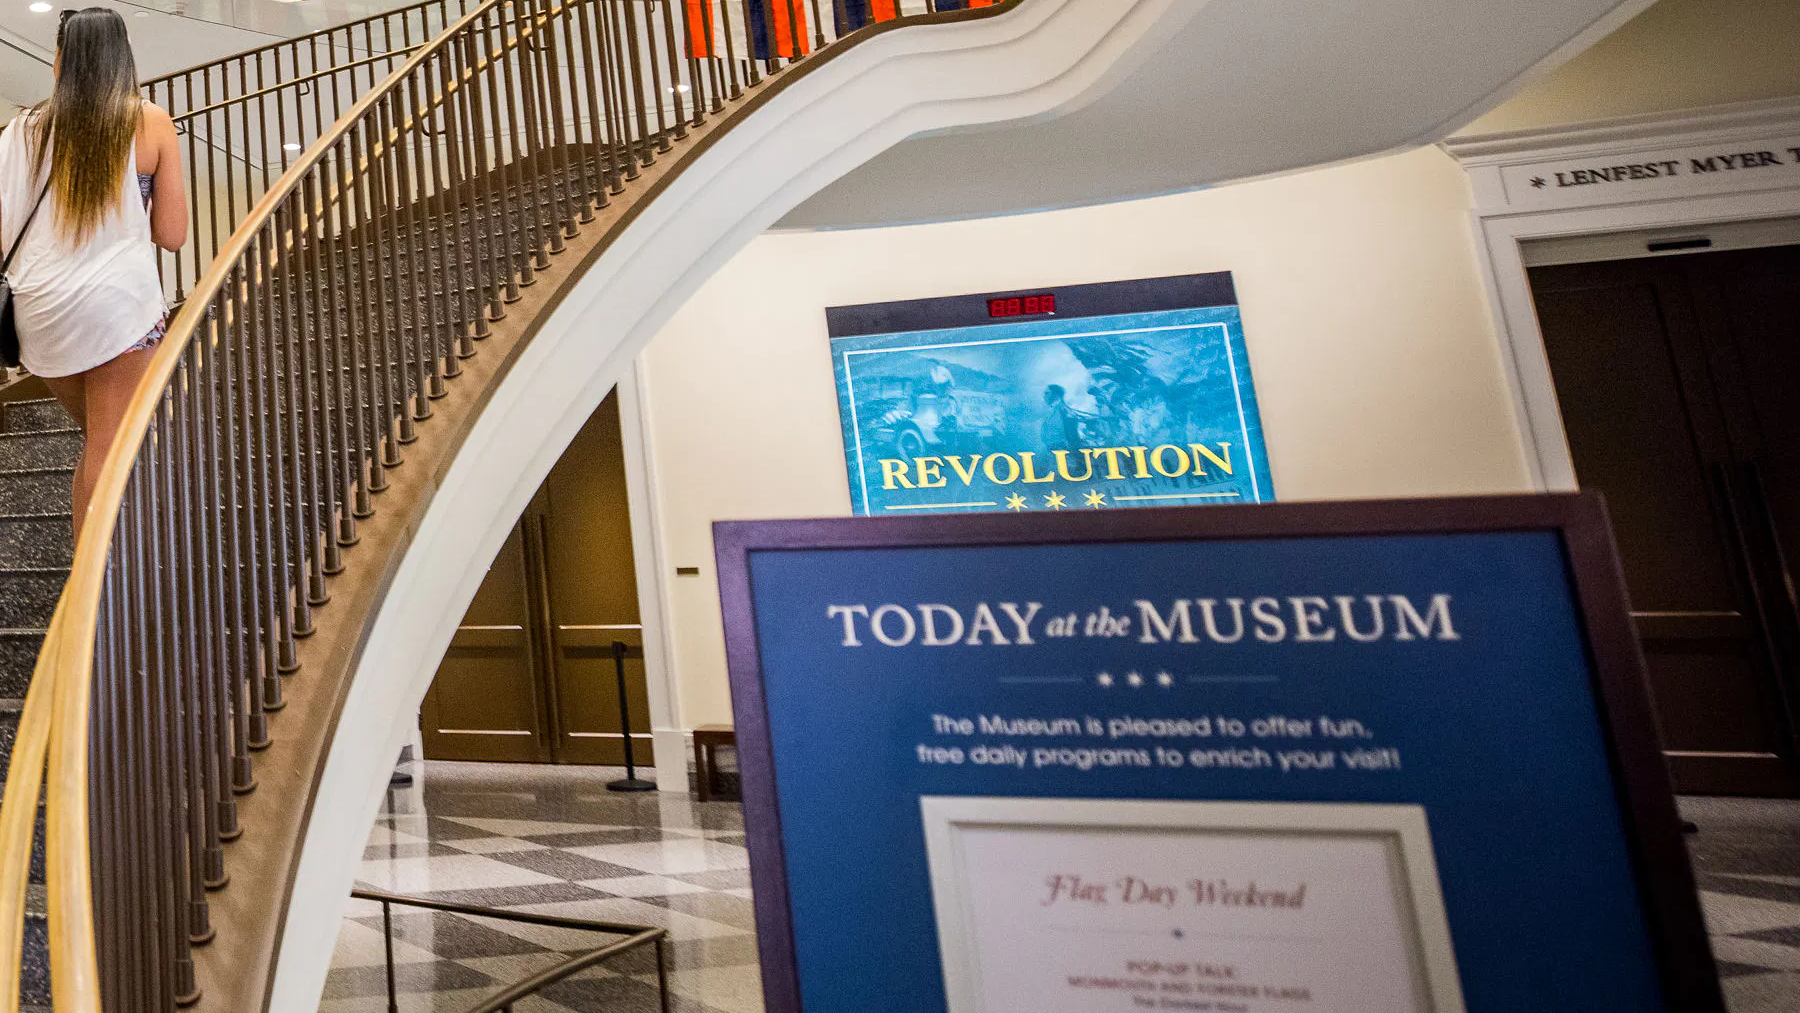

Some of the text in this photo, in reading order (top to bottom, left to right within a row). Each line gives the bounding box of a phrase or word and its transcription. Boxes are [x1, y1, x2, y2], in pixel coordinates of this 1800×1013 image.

[1554, 160, 1680, 187] LENFEST
[1689, 151, 1784, 174] MYER
[878, 441, 1234, 490] REVOLUTION
[827, 593, 1461, 648] TODAY at the MUSEUM
[931, 713, 974, 735] The
[978, 713, 1081, 736] Museum
[1085, 714, 1104, 736] is
[1108, 714, 1212, 740] pleased
[1216, 714, 1246, 737] to
[1251, 715, 1312, 737] offer
[916, 743, 965, 765] free
[969, 744, 1027, 769] daily
[1032, 747, 1151, 771] programs
[1155, 745, 1184, 768] to
[1188, 746, 1273, 769] enrich
[1276, 750, 1336, 773] your
[1039, 874, 1307, 909] Flag Day Weekend
